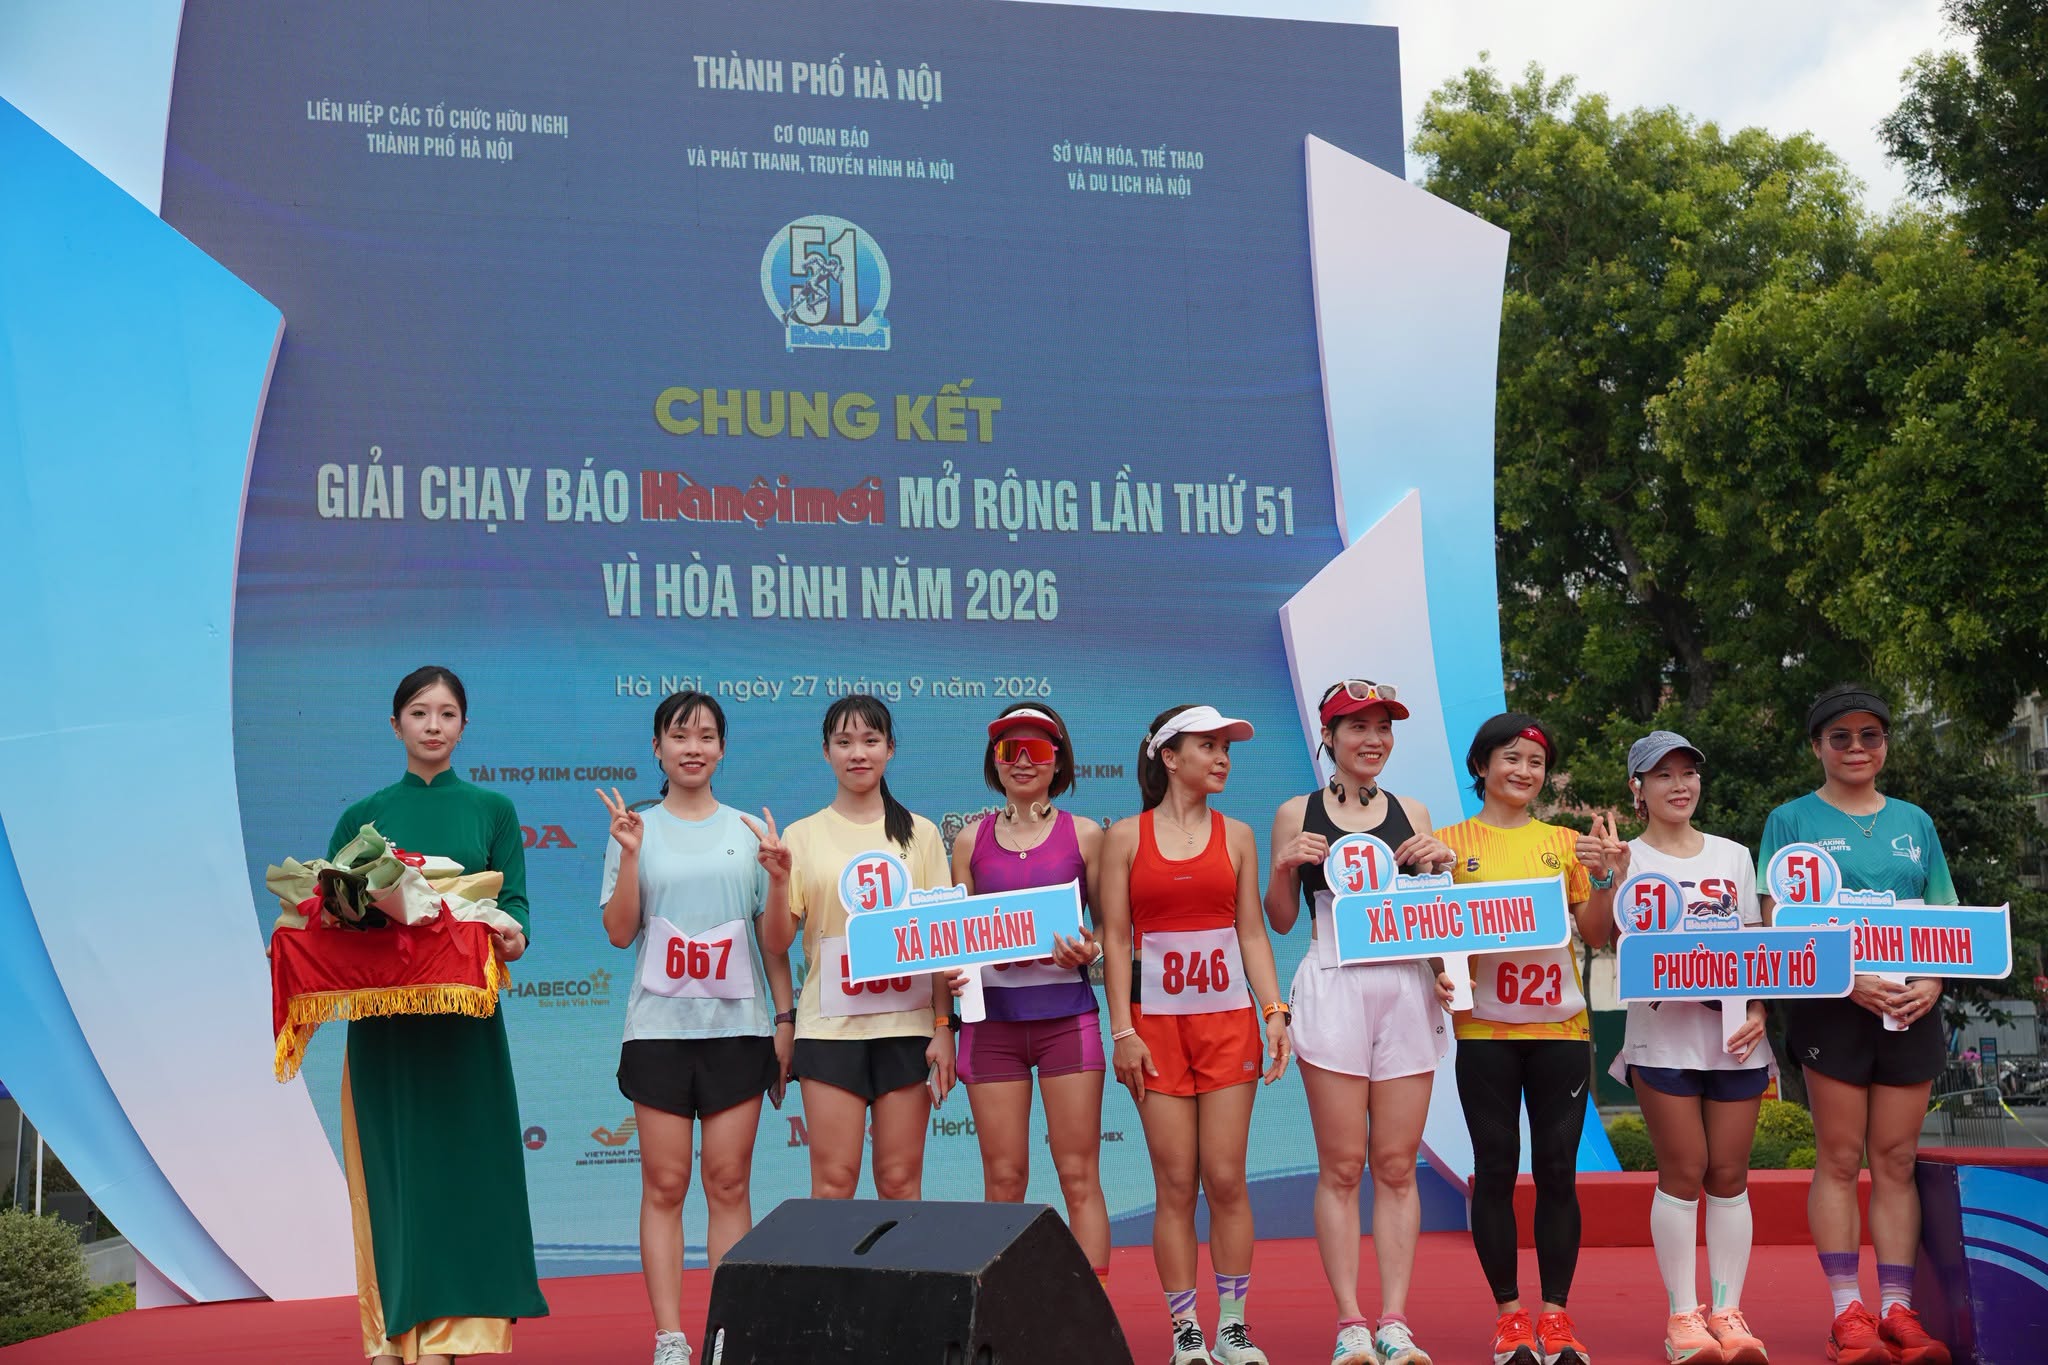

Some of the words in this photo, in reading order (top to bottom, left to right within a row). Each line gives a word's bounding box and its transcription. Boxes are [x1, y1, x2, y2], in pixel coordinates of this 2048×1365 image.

[693, 50, 783, 93] THÀNH
[791, 53, 846, 97] PHỐ
[853, 60, 889, 99] HÀ
[897, 62, 943, 109] NỘI
[306, 97, 343, 122] LIÊN
[347, 100, 384, 127] HIỆP
[388, 103, 421, 127] CÁC
[426, 101, 445, 128] TỔ
[449, 106, 492, 131] CHỨC
[495, 107, 527, 133] HỮU
[531, 114, 569, 139] NGHỊ
[773, 124, 794, 143] CƠ
[798, 126, 837, 147] QUAN
[840, 126, 870, 148] BÁO
[367, 131, 419, 155] THÀNH
[423, 132, 455, 157] PHỐ
[460, 136, 482, 159] HÀ
[486, 137, 513, 164] NỘI
[687, 145, 707, 167] VÀ
[711, 147, 748, 169] PHÁT
[752, 152, 805, 175] THANH,
[868, 156, 903, 178] HÌNH
[906, 158, 926, 179] HÀ
[929, 159, 955, 184] NỘI
[1053, 139, 1071, 163] SỞ
[1075, 143, 1103, 165] VĂN
[1106, 144, 1139, 168] HÓA,
[1140, 143, 1167, 168] THỂ
[1169, 150, 1204, 170] THAO
[1068, 169, 1086, 191] VÀ
[1090, 173, 1108, 192] DU
[1112, 174, 1142, 196] LỊCH
[1146, 173, 1165, 195] HÀ
[1168, 174, 1191, 199] NỘI
[789, 225, 859, 327] 51
[654, 386, 880, 440] CHUNG
[895, 378, 1001, 443] KẾT
[317, 445, 404, 520] GIẢI
[419, 466, 532, 533] CHẠY
[545, 457, 629, 524] BÁO
[898, 459, 961, 530] MỞ
[973, 467, 1079, 542] RỘNG
[1090, 464, 1164, 534] LẦN
[1173, 473, 1247, 536] THỨ
[1255, 485, 1295, 537] 51
[602, 551, 641, 617] VÌ
[655, 551, 739, 618] HÒA
[751, 554, 847, 619] BÌNH
[861, 555, 953, 620] NĂM
[965, 568, 1059, 621] 2026
[615, 675, 652, 697] Hà
[718, 675, 784, 701] ngày
[791, 676, 819, 697] 27
[825, 675, 902, 702] tháng
[908, 676, 924, 697] 9
[932, 676, 986, 697] năm
[993, 676, 1052, 698] 2026
[469, 765, 496, 782] TÀI
[499, 766, 536, 785] TRỢ
[539, 767, 571, 781] KIM
[573, 765, 638, 781] CƯƠNG
[1096, 764, 1124, 778] KIM
[856, 861, 893, 911] 51
[1342, 845, 1379, 893] 51
[1786, 856, 1822, 904] 51
[1366, 899, 1400, 944] XÃ
[1402, 896, 1465, 942] PHÚC
[1467, 896, 1537, 943] THỊNH
[1635, 883, 1667, 931] 51
[665, 936, 733, 981] 667
[893, 919, 925, 963] XÃ
[929, 920, 960, 960] AN
[962, 907, 1037, 954] KHÁNH
[1854, 918, 1905, 963] BÌNH
[1910, 926, 1973, 965] MINH
[1162, 948, 1230, 996] 846
[1496, 961, 1563, 1007] 623
[1653, 942, 1738, 991] PHƯỜNG
[1743, 943, 1783, 988] TÂY
[1787, 937, 1818, 988] HỒ
[508, 980, 591, 999] HABECO
[932, 1117, 978, 1137] Herb
